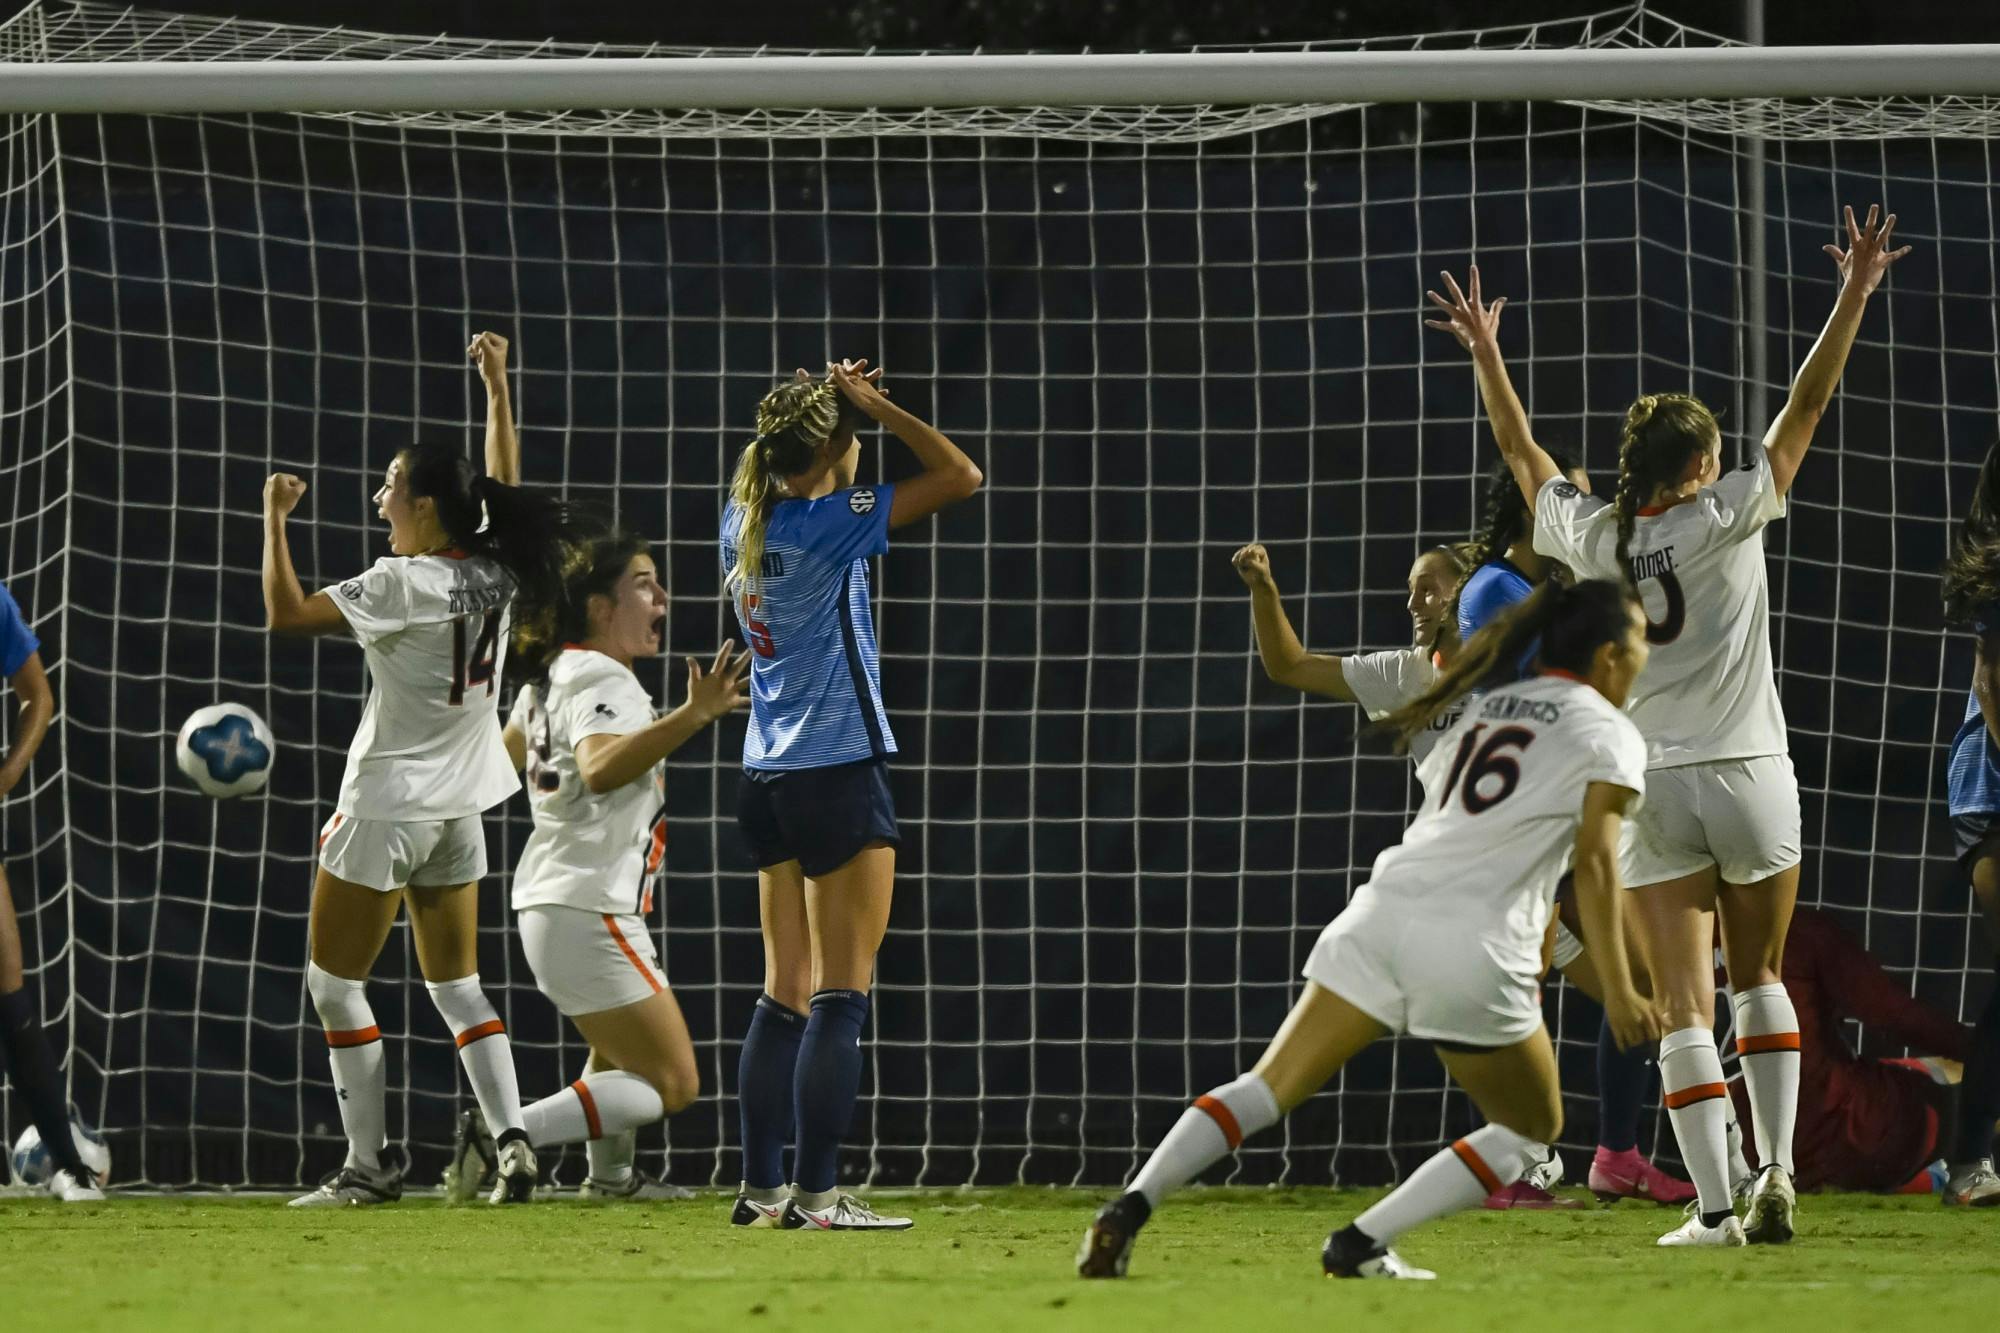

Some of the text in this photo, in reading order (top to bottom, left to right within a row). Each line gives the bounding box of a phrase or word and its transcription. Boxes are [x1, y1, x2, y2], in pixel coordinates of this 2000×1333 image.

[850, 490, 875, 513] SEC
[448, 608, 497, 706] 14
[1439, 722, 1536, 816] 16
